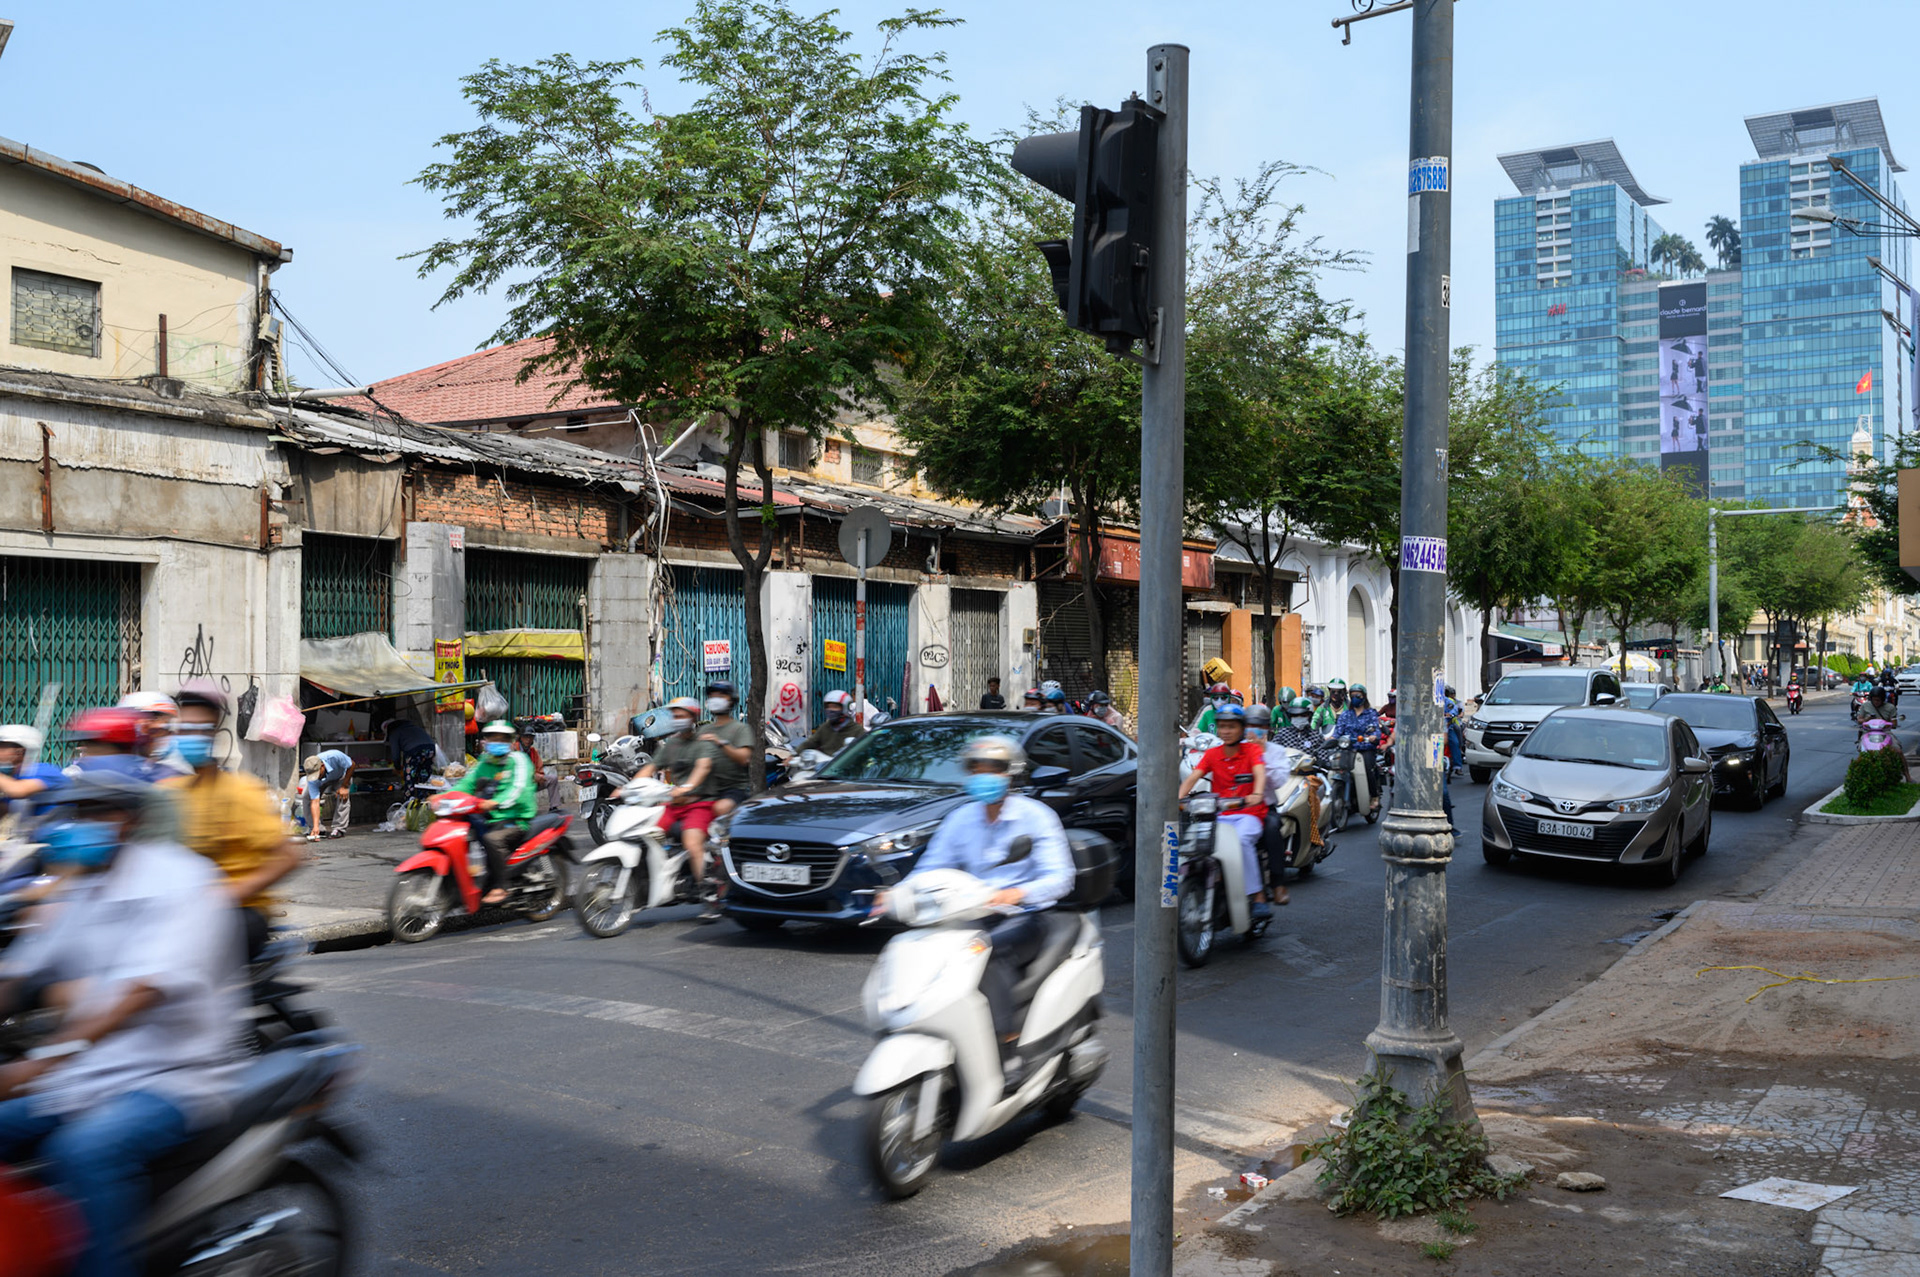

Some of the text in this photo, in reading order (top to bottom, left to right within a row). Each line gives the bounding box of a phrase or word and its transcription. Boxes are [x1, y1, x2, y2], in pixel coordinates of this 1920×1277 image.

[1660, 308, 1680, 316] claude
[1681, 304, 1706, 314] bernard
[923, 651, 946, 663] 92C5
[775, 659, 802, 673] 92C5
